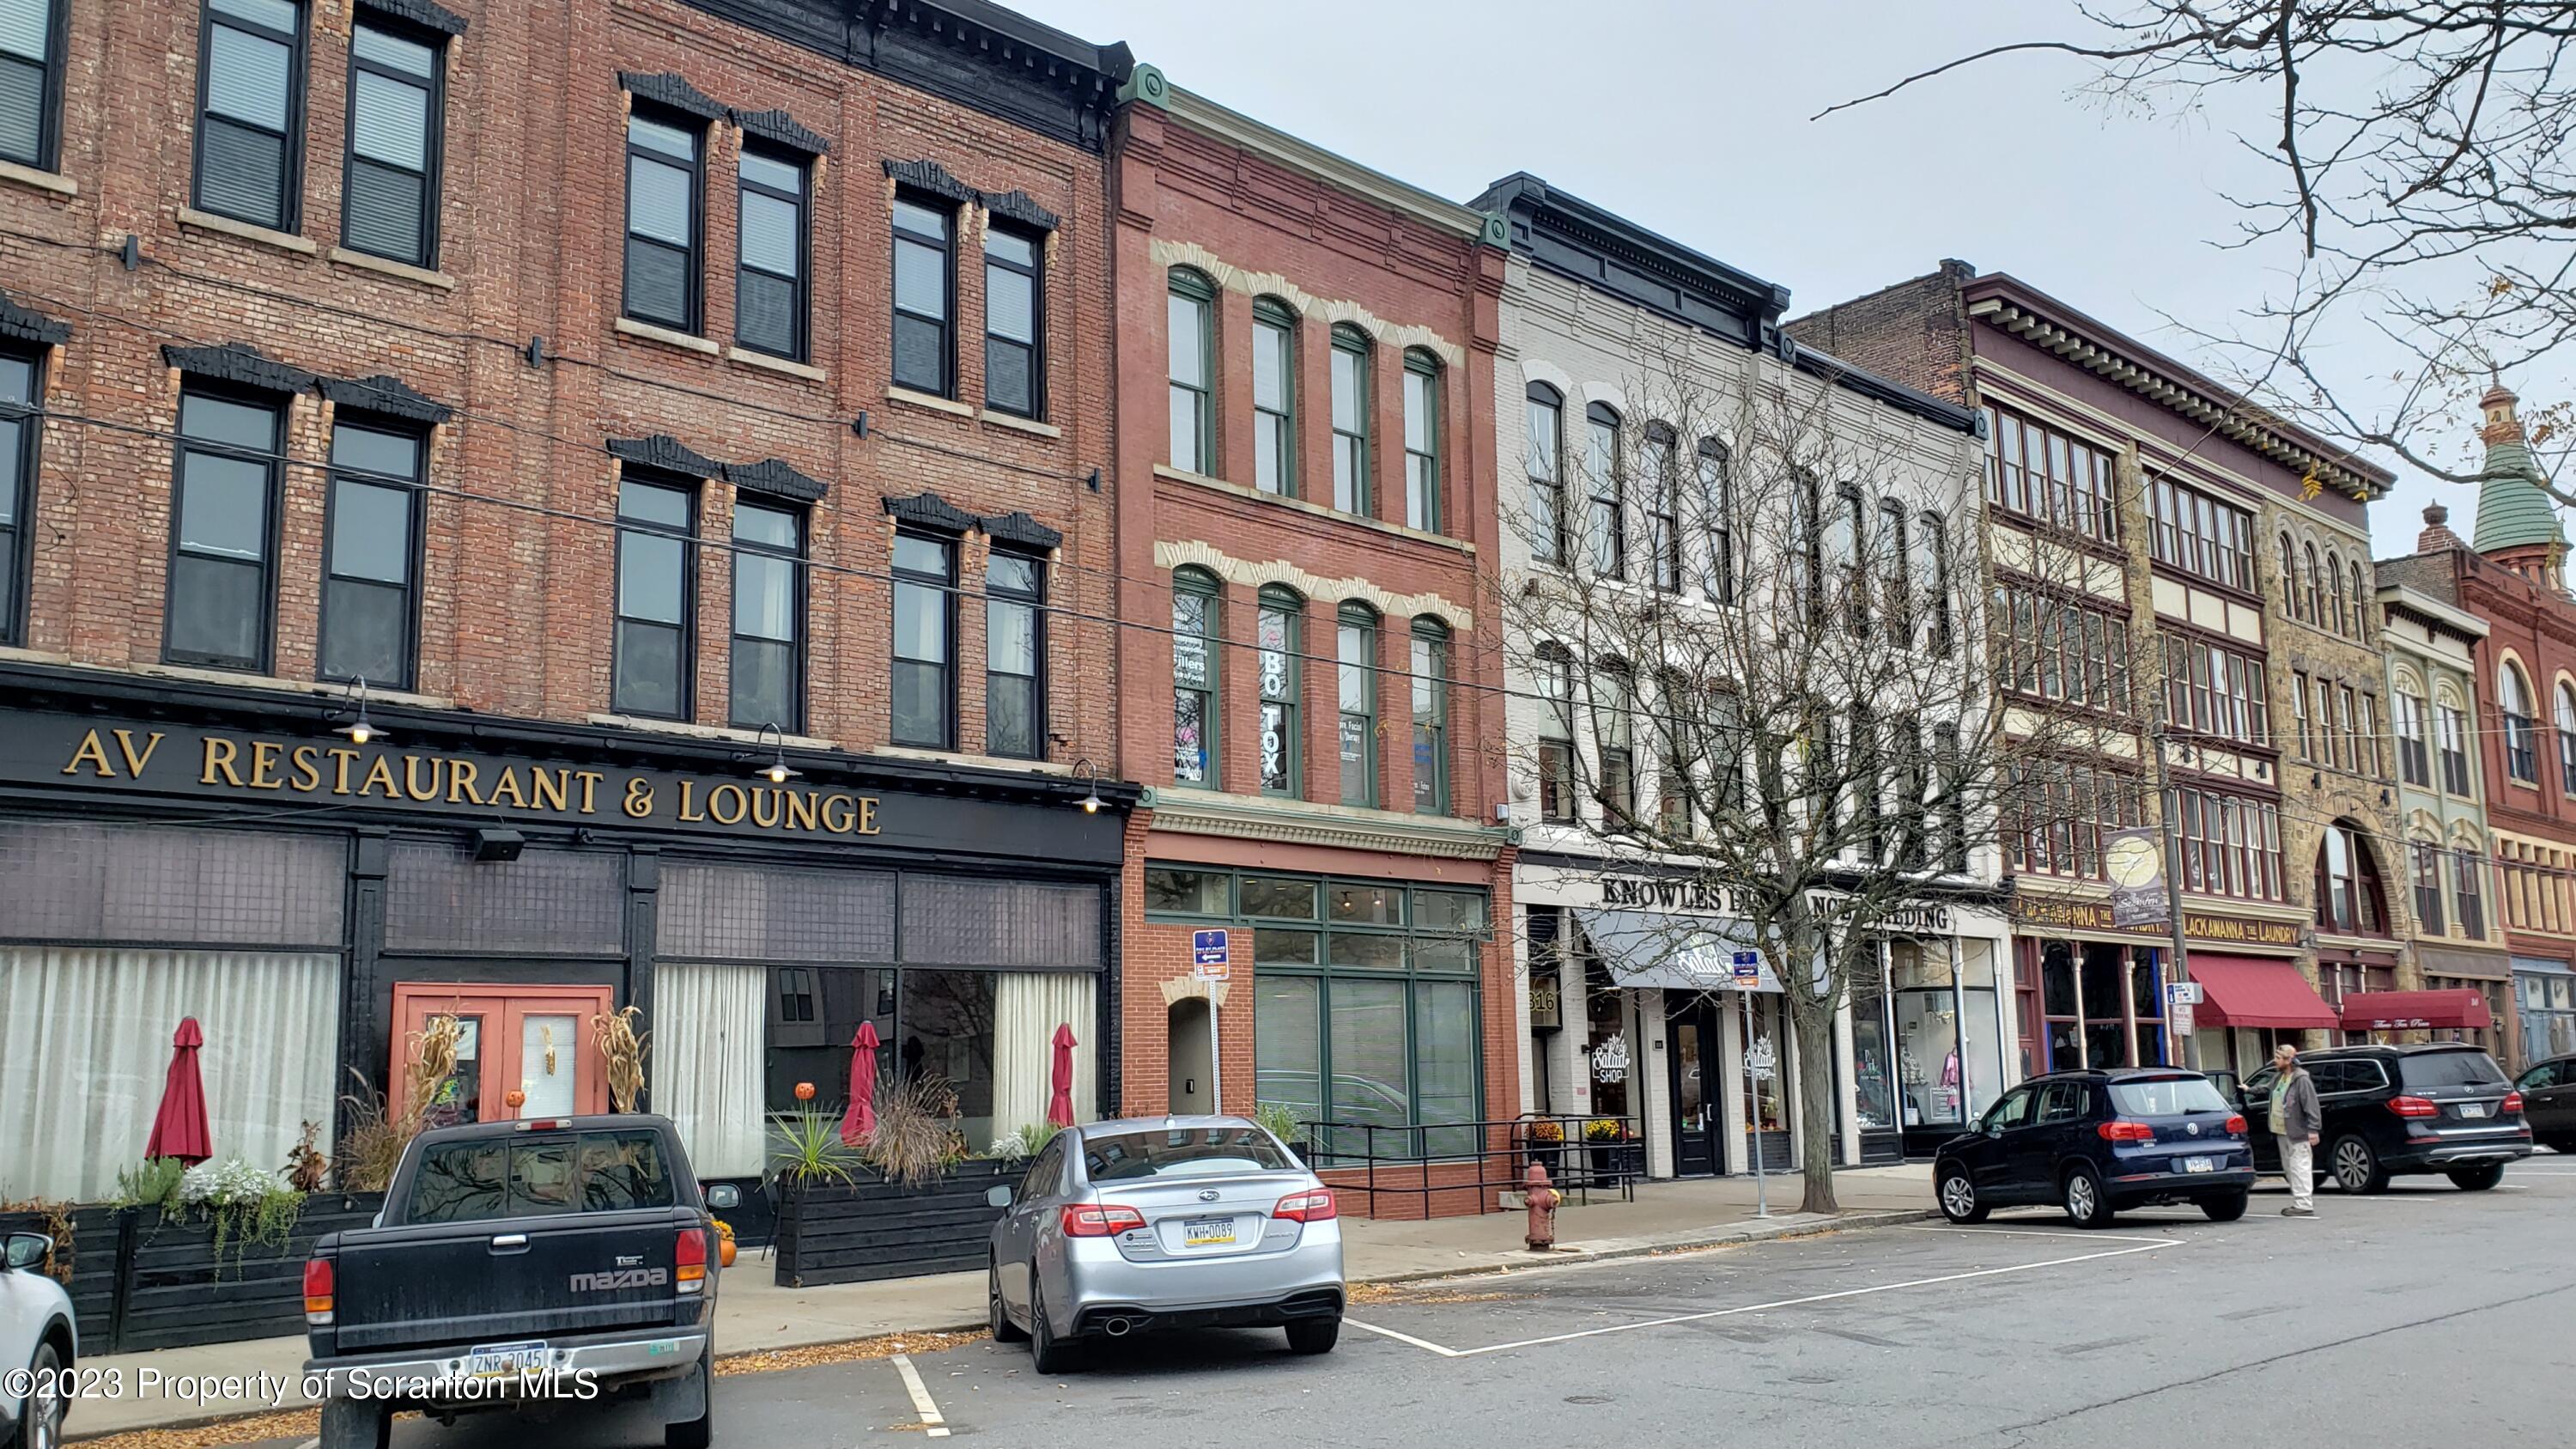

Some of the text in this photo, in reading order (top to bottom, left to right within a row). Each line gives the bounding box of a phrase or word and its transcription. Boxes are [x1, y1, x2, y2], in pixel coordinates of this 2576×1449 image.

[62, 728, 881, 835] AV RESTAURANT & LOUNGE
[1601, 878, 1722, 910] KNOWLES
[2099, 910, 2112, 922] THE
[2184, 914, 2245, 941] LACKAWANNA
[2257, 920, 2297, 944] LAUNDRY
[1592, 1045, 1629, 1070] Salad
[1600, 1069, 1623, 1083] SHOP
[570, 1267, 667, 1292] mazda
